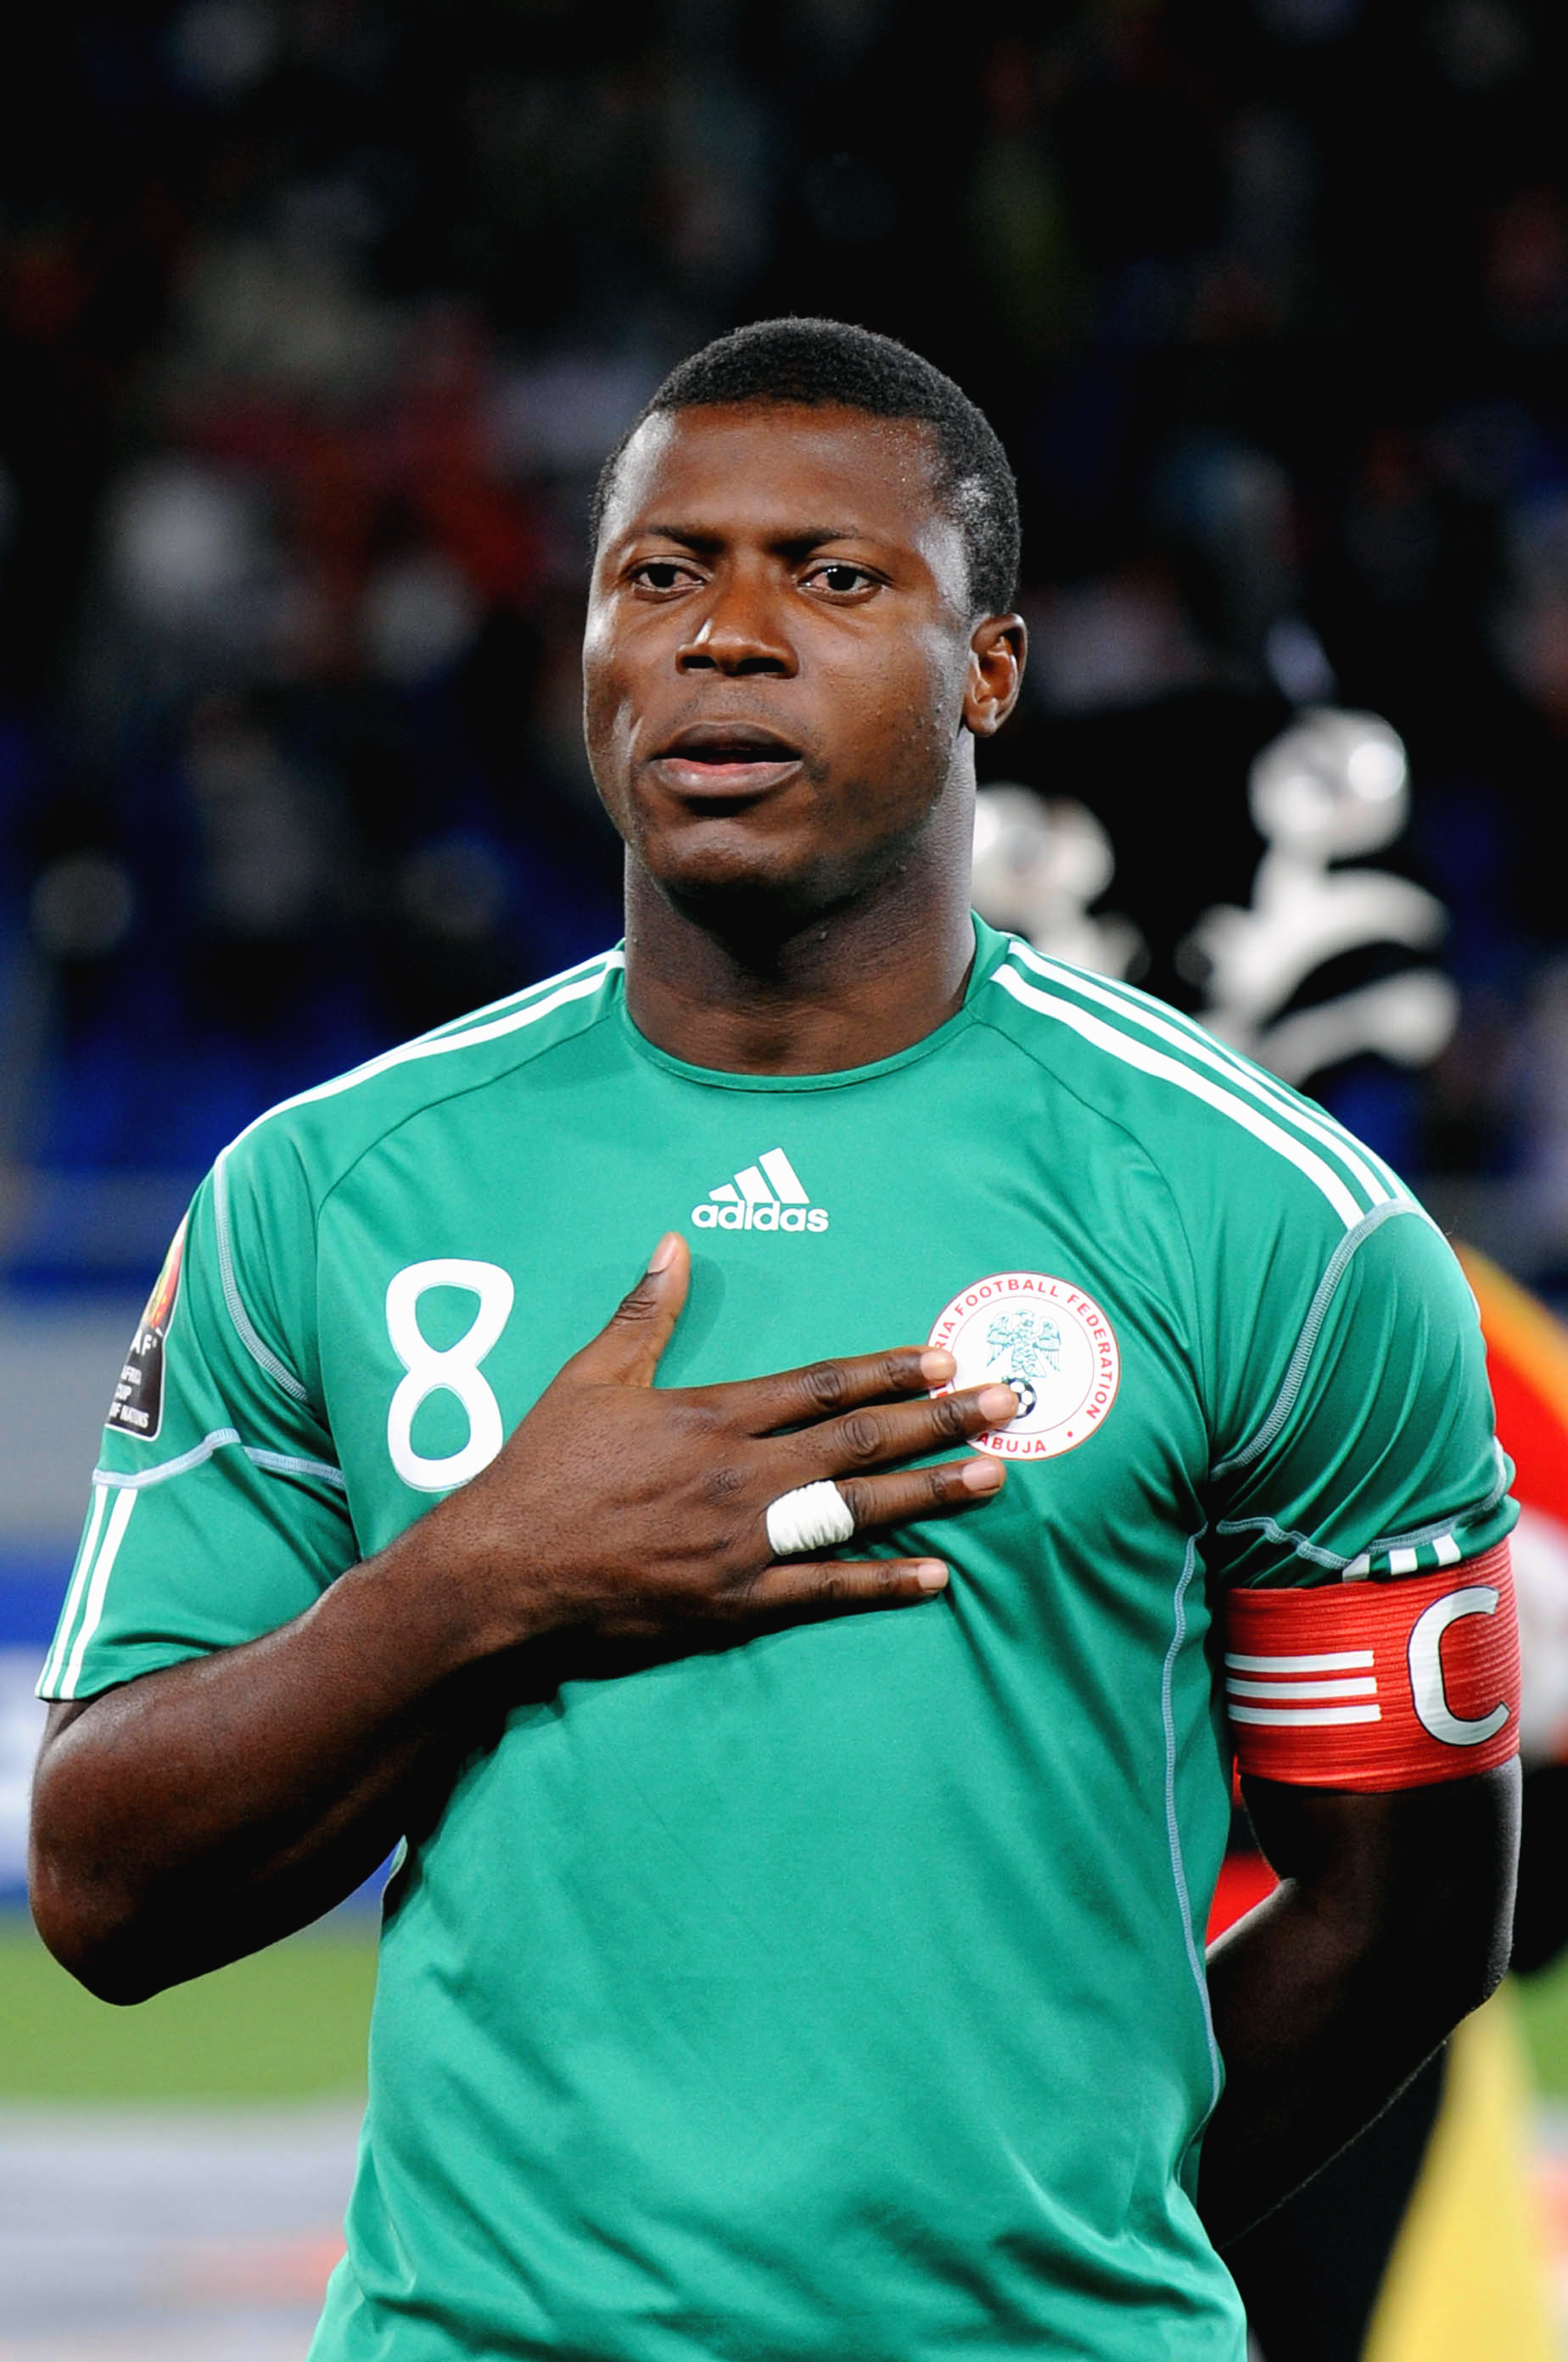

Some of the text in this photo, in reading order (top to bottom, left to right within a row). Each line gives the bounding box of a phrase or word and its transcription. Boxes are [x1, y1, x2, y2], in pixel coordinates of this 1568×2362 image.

[691, 1199, 830, 1234] adidas
[386, 1258, 514, 1492] 8
[954, 1278, 1060, 1317] FOOTBALL
[1066, 1293, 1113, 1420] FEDERATION
[976, 1431, 1047, 1453] ABUJA
[1407, 1585, 1511, 1747] C
